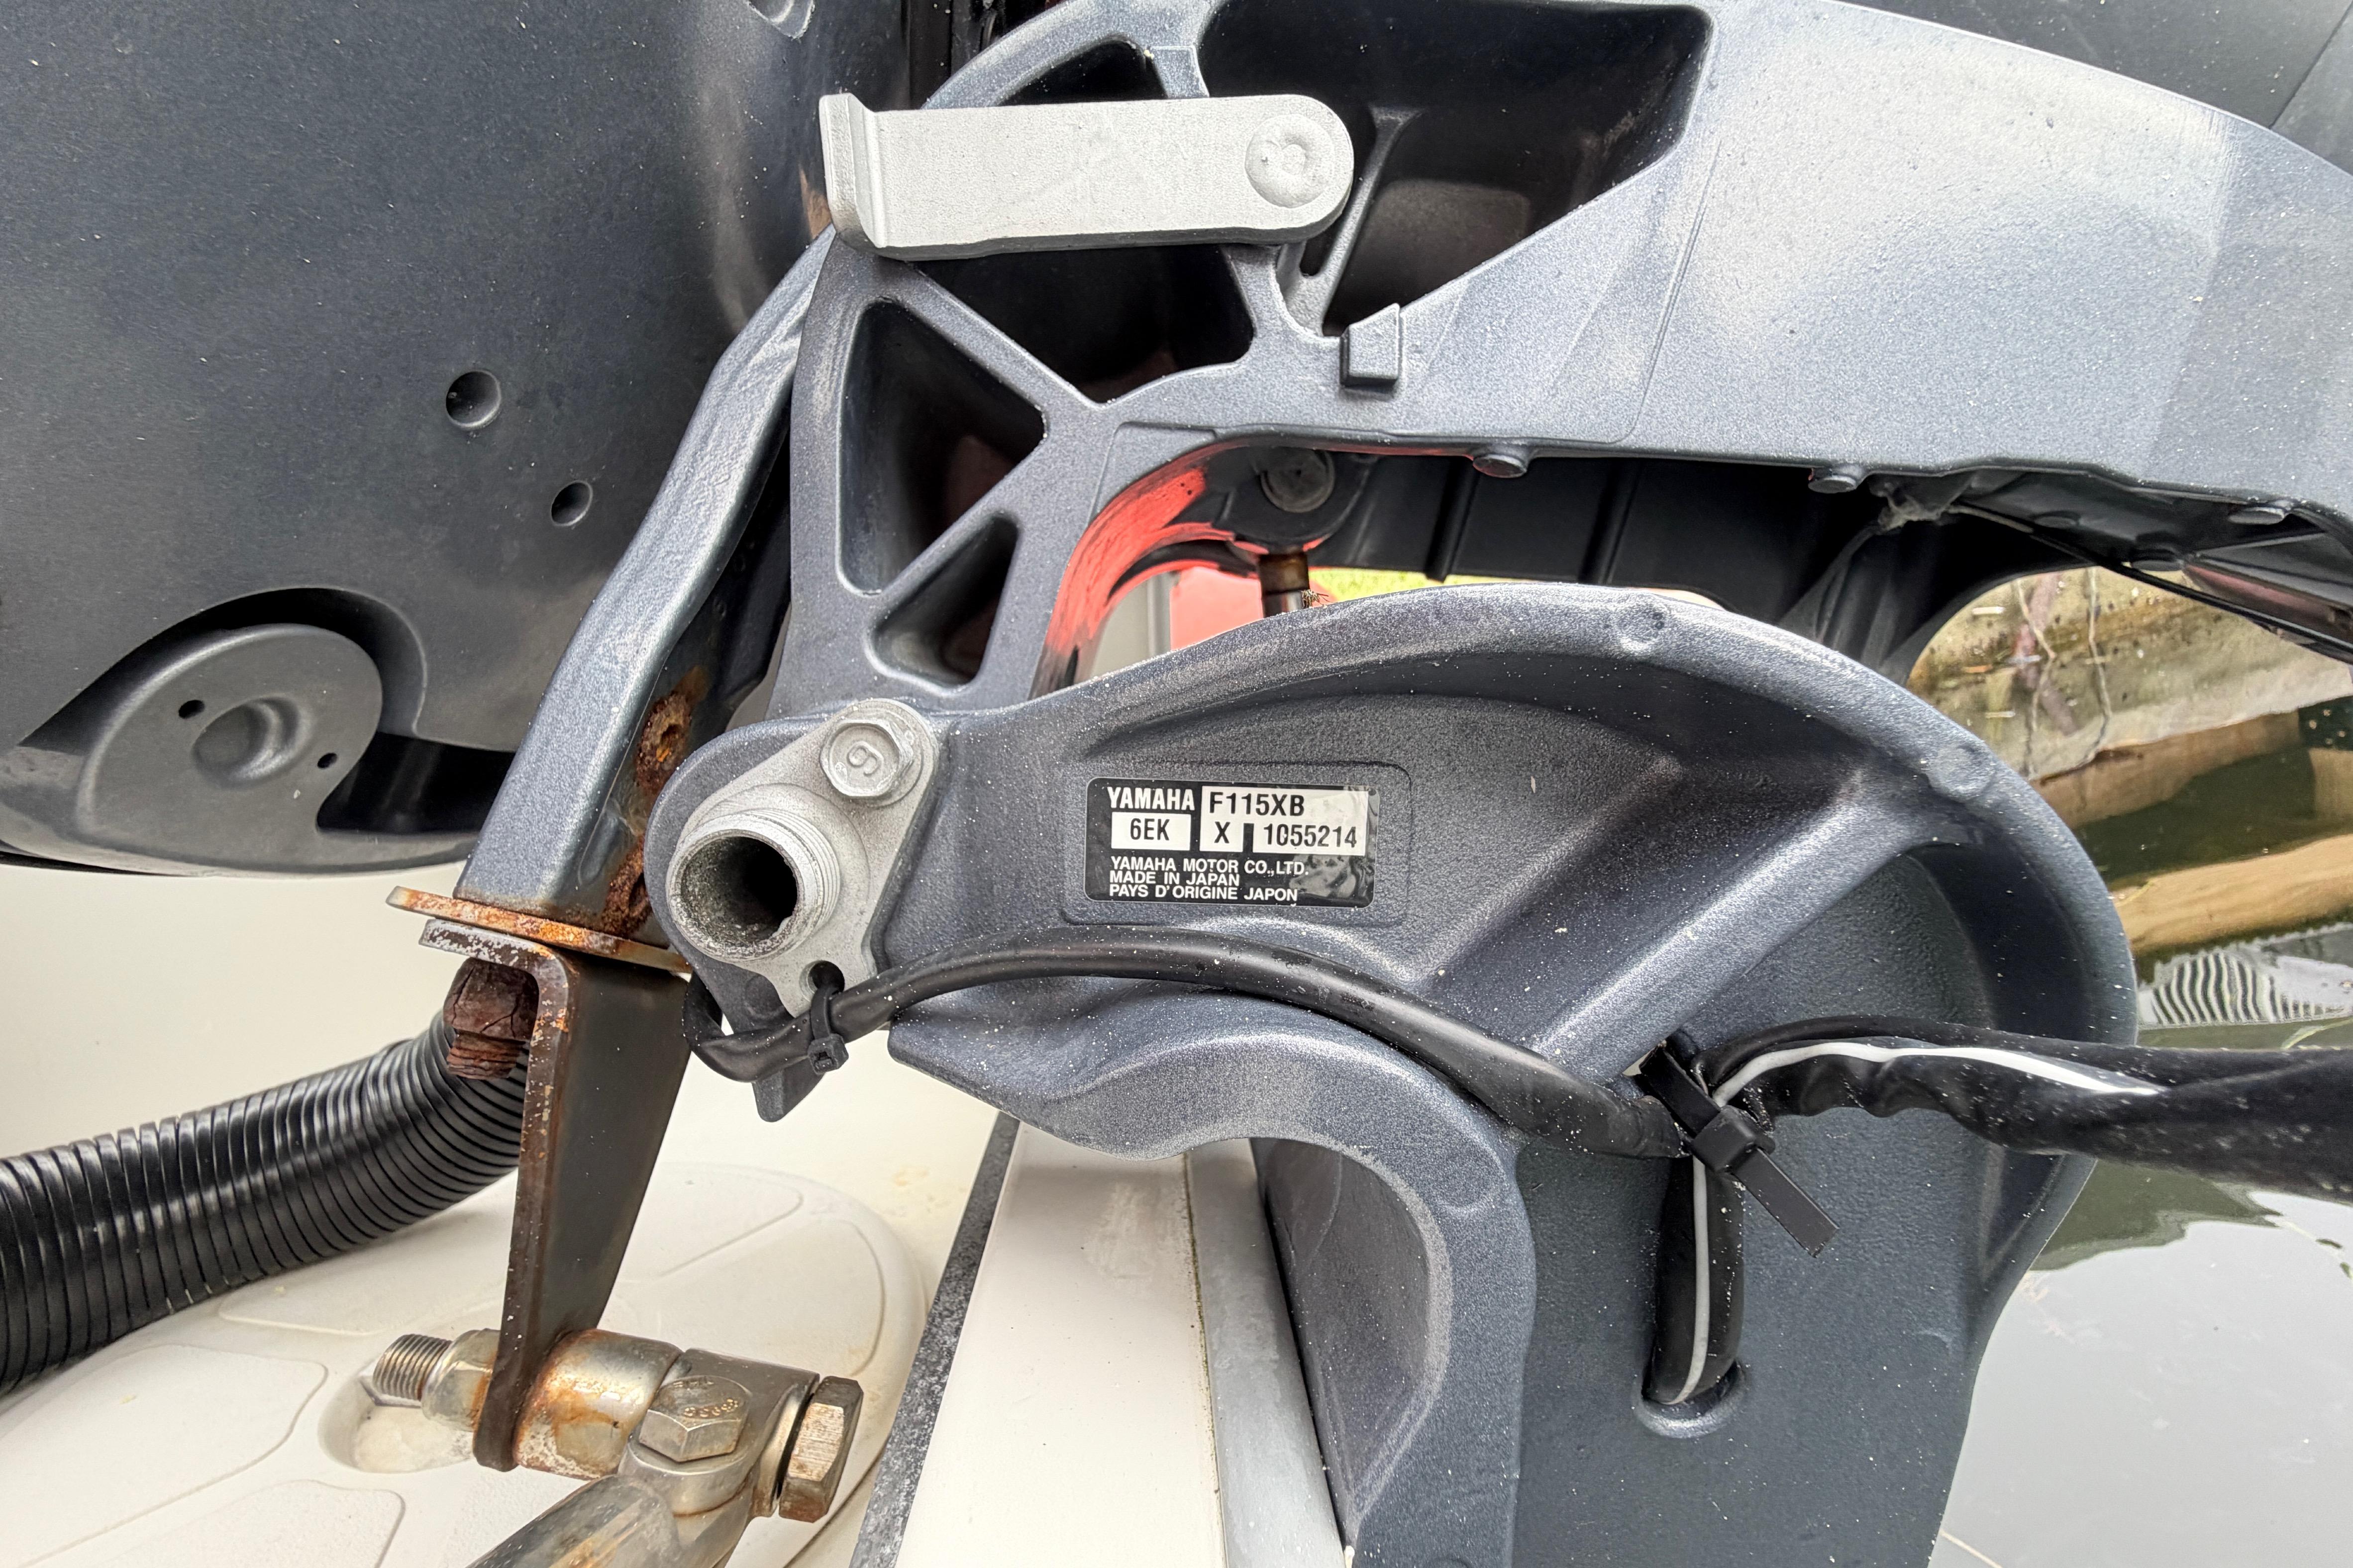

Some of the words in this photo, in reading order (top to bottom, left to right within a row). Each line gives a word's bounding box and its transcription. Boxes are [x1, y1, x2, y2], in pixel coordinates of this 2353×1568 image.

[1107, 786, 1195, 810] YAMAHA
[1210, 791, 1305, 816] F115XB
[1130, 818, 1170, 841] 6EK
[1214, 821, 1230, 844] X
[1263, 823, 1357, 848] 1055214
[1111, 856, 1176, 871] YAMAHA
[1183, 858, 1238, 874] MOTOR
[1110, 870, 1156, 884] MADE
[1164, 872, 1180, 884] IN
[1186, 873, 1239, 886] JAPAN
[1109, 884, 1148, 897] PAYS
[1155, 884, 1238, 900] D'ORIGINE
[1243, 887, 1298, 901] JAPON
